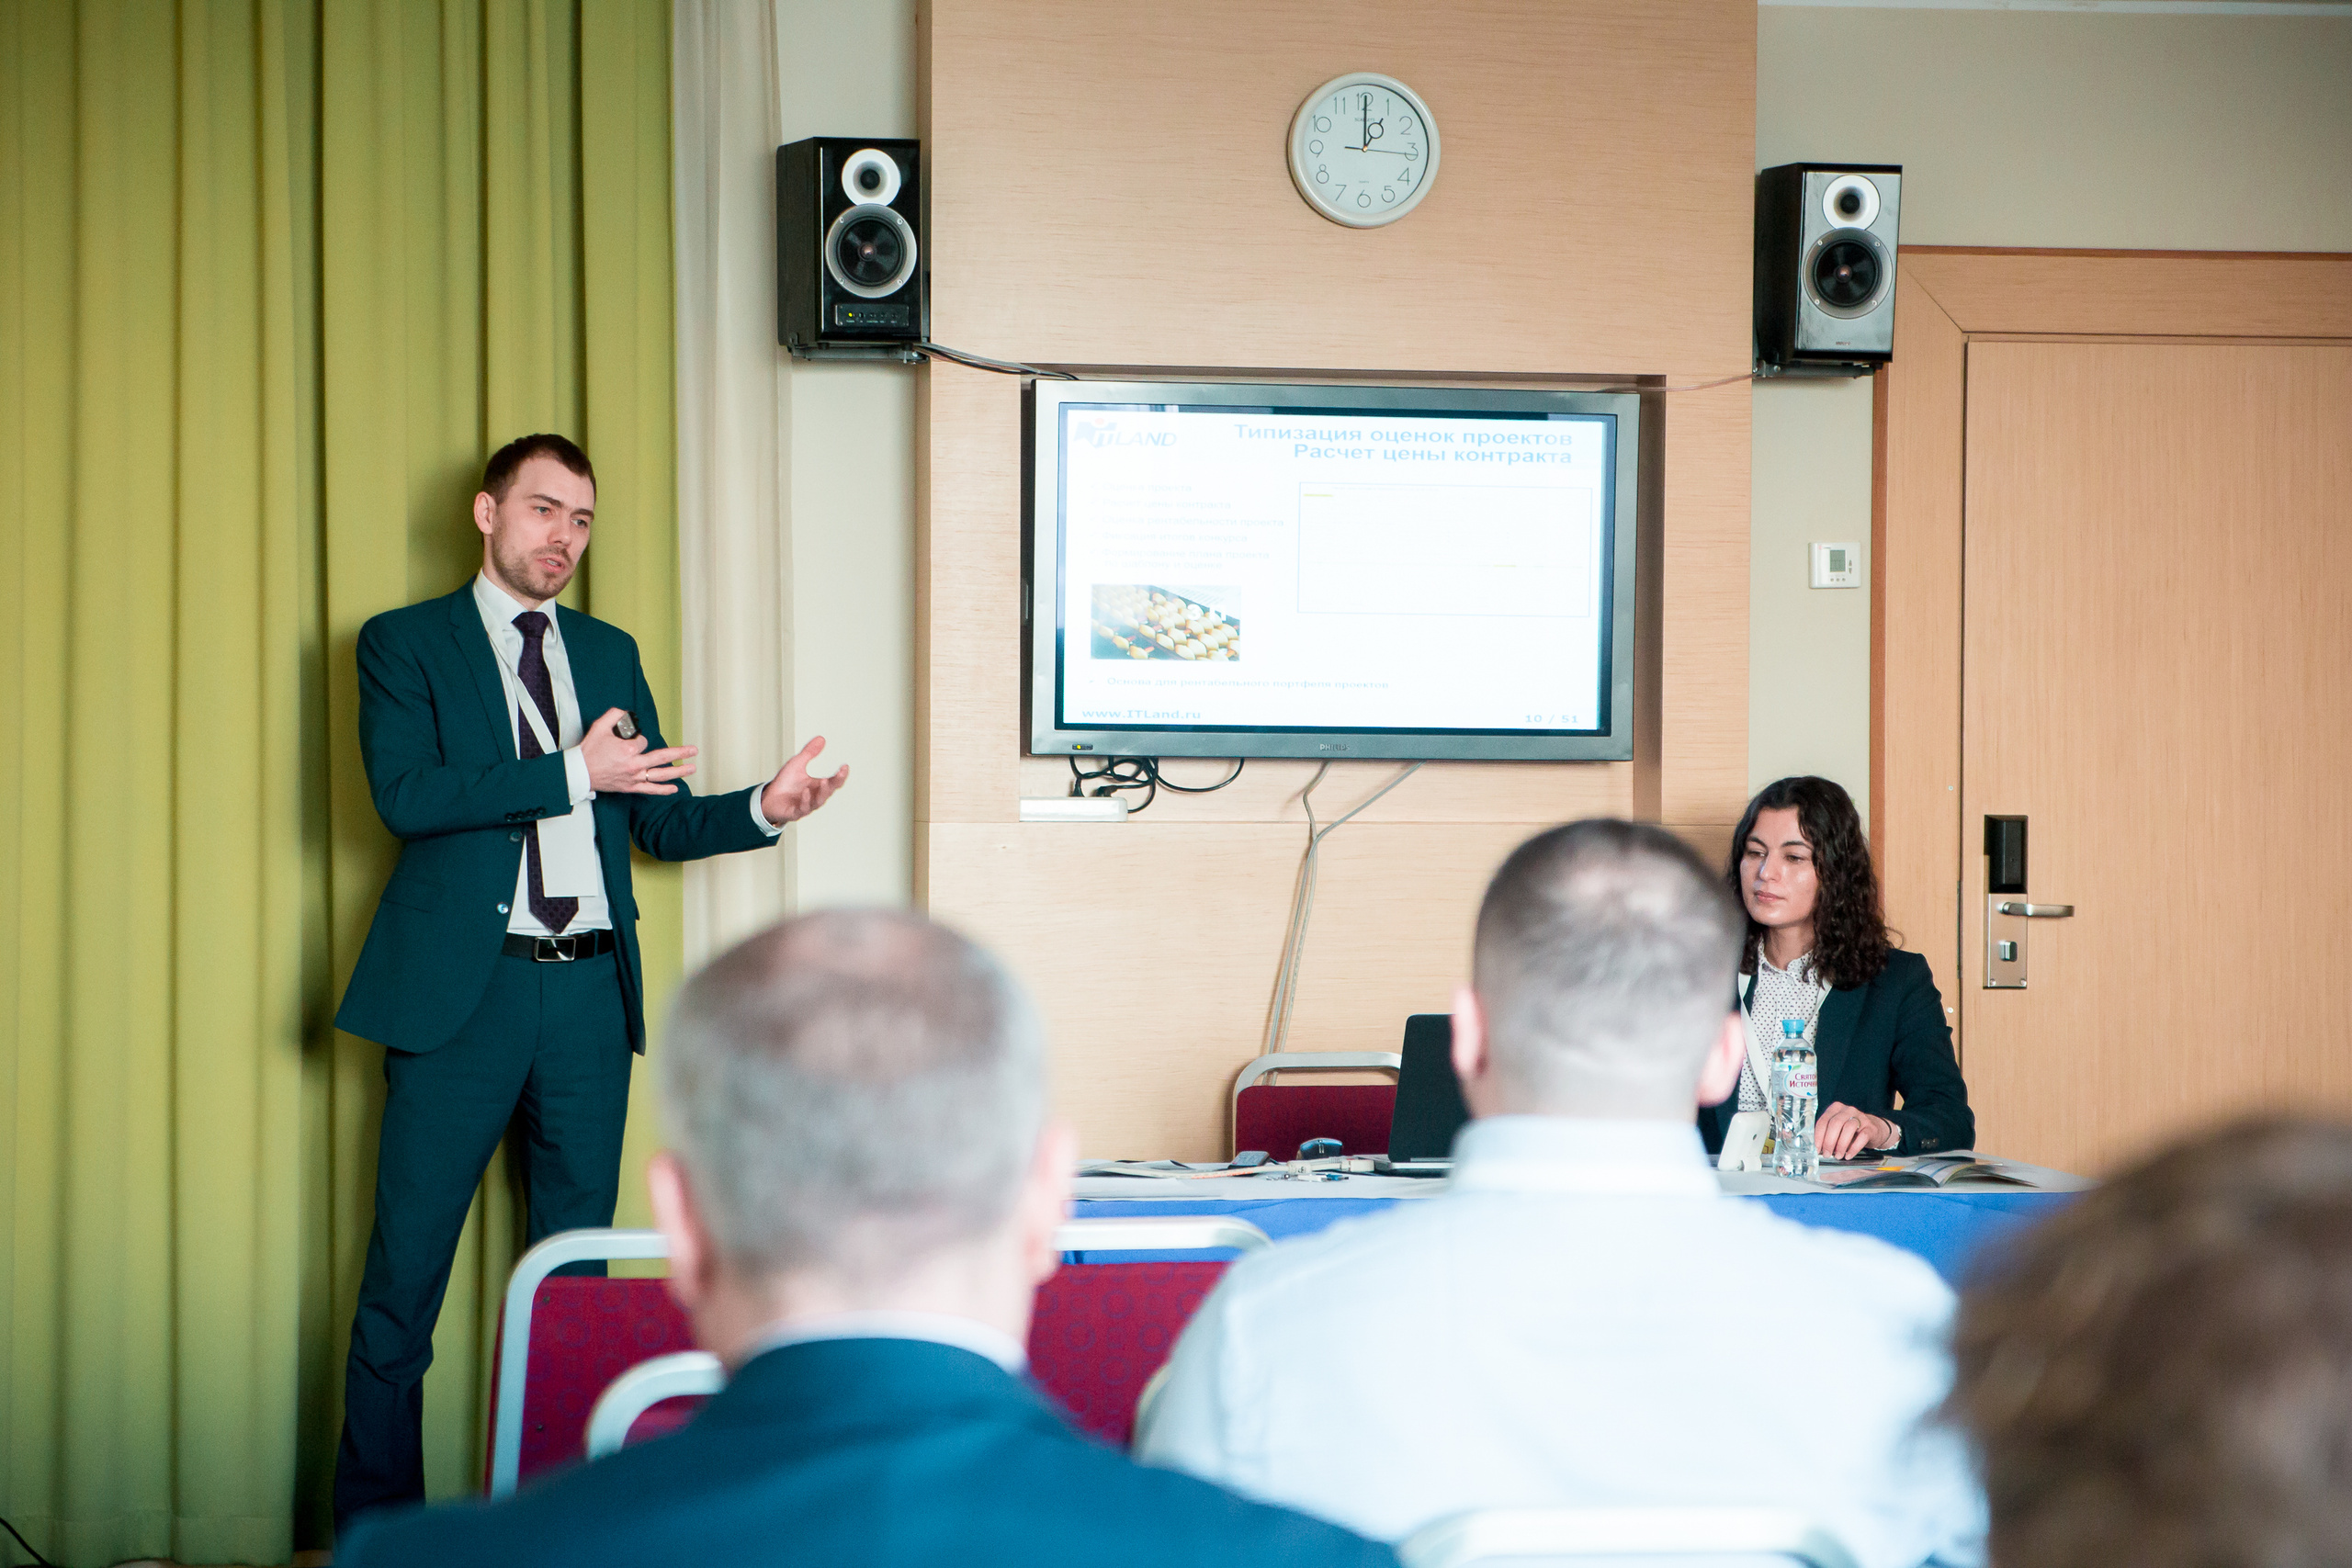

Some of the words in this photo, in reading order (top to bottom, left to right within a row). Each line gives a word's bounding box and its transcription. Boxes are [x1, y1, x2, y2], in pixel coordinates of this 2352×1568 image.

[1334, 96, 1346, 115] 11
[1357, 92, 1374, 112] 12
[1385, 97, 1390, 116] 1
[1313, 114, 1332, 133] 10
[1398, 116, 1413, 135] 2
[1309, 140, 1324, 158] 9
[1404, 142, 1419, 162] 3
[1316, 164, 1329, 184] 8
[1396, 167, 1411, 186] 4
[1335, 184, 1347, 202] 7
[1357, 189, 1371, 208] 6
[1382, 186, 1396, 203] 5
[1234, 424, 1362, 443] Типизация
[1371, 430, 1454, 445] оценок
[1463, 432, 1573, 447] проектов
[1294, 444, 1375, 459] Расчет
[1384, 448, 1446, 462] цены
[1454, 450, 1572, 465] контракта
[1148, 485, 1193, 493] проекта
[1144, 501, 1173, 509] цены
[1176, 501, 1231, 510] контракта
[1148, 516, 1237, 526] рентабельности
[1240, 519, 1284, 529] проекта
[1159, 534, 1195, 542] итогов
[1198, 535, 1248, 544] конкурса
[1226, 551, 1270, 560] проекта
[1183, 562, 1223, 570] оценке
[1106, 677, 1151, 685] Основа
[1155, 679, 1177, 687] для
[1182, 678, 1270, 689] рентабельного
[1273, 680, 1331, 690] портфеля
[1335, 682, 1389, 691] проектов
[1082, 709, 1202, 719] www.ITLand.ru
[1525, 715, 1543, 723] 10
[1561, 715, 1578, 724] 51
